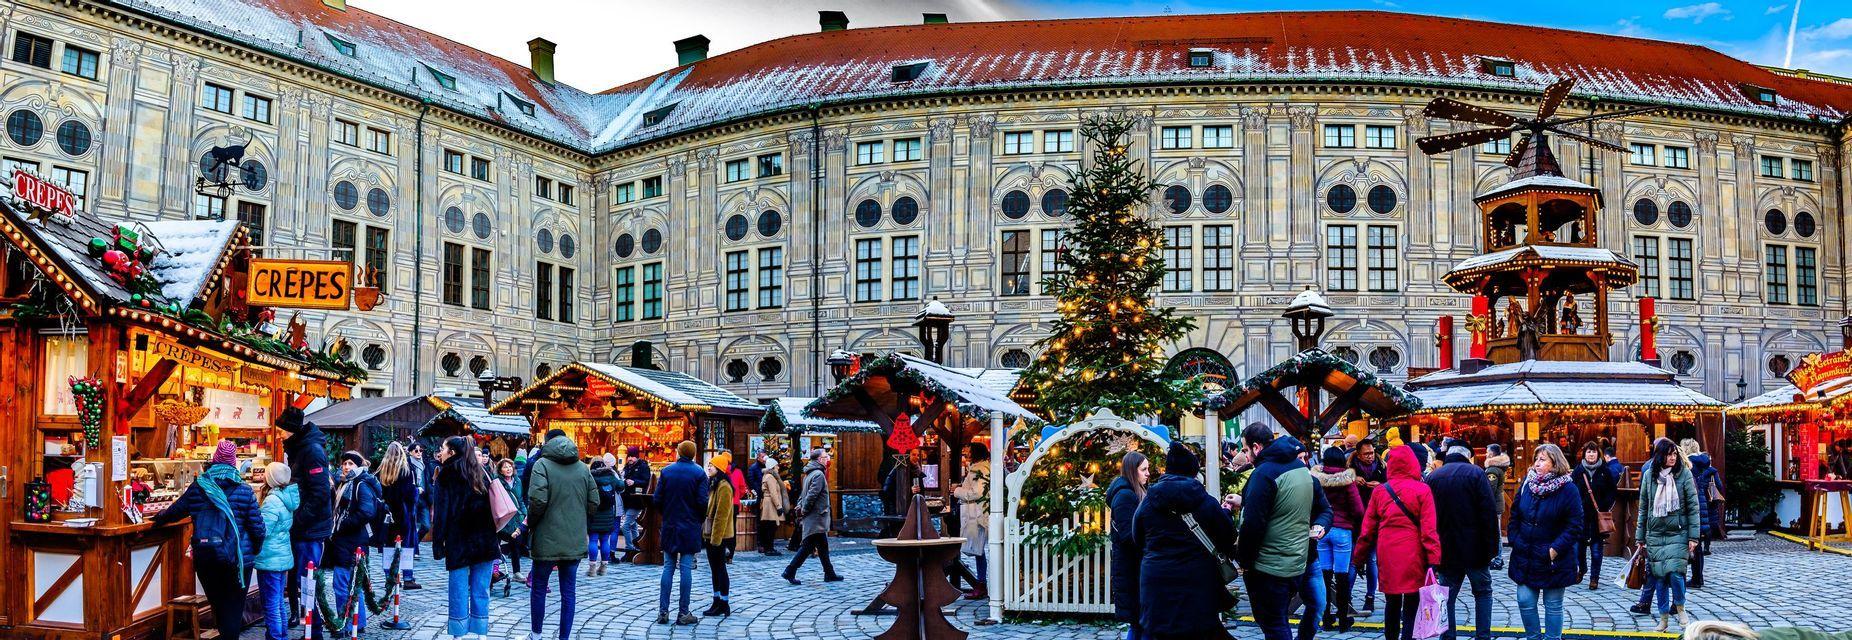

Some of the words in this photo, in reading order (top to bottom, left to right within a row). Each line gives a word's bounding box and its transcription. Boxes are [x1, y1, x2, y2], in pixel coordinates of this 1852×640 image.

[15, 173, 74, 218] CRÊPES
[254, 266, 346, 300] CRÊPES
[156, 341, 222, 373] CRÊPES
[1816, 353, 1852, 368] Getränke
